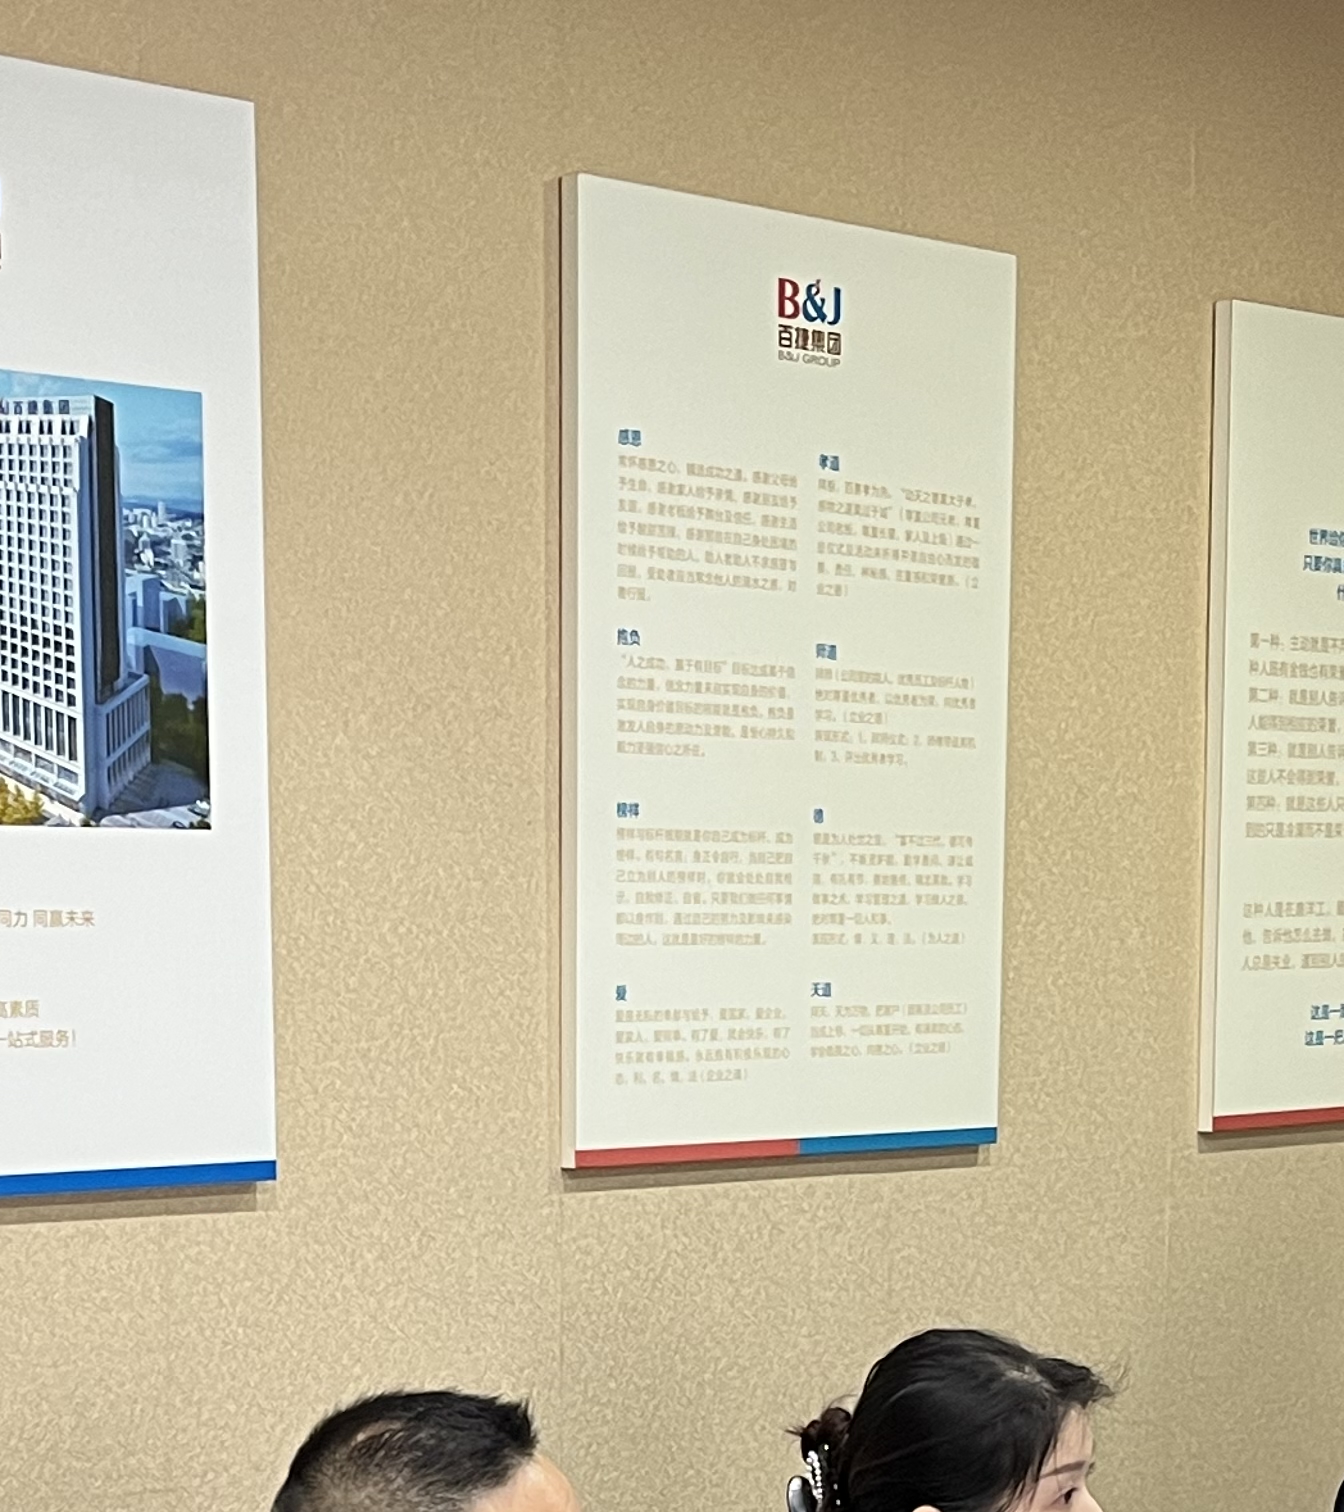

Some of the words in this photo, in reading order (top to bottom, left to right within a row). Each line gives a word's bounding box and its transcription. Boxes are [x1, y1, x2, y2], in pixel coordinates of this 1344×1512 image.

[777, 277, 842, 326] B&J
[777, 323, 842, 356] 百捷集团
[33, 909, 96, 928] 同赢未来
